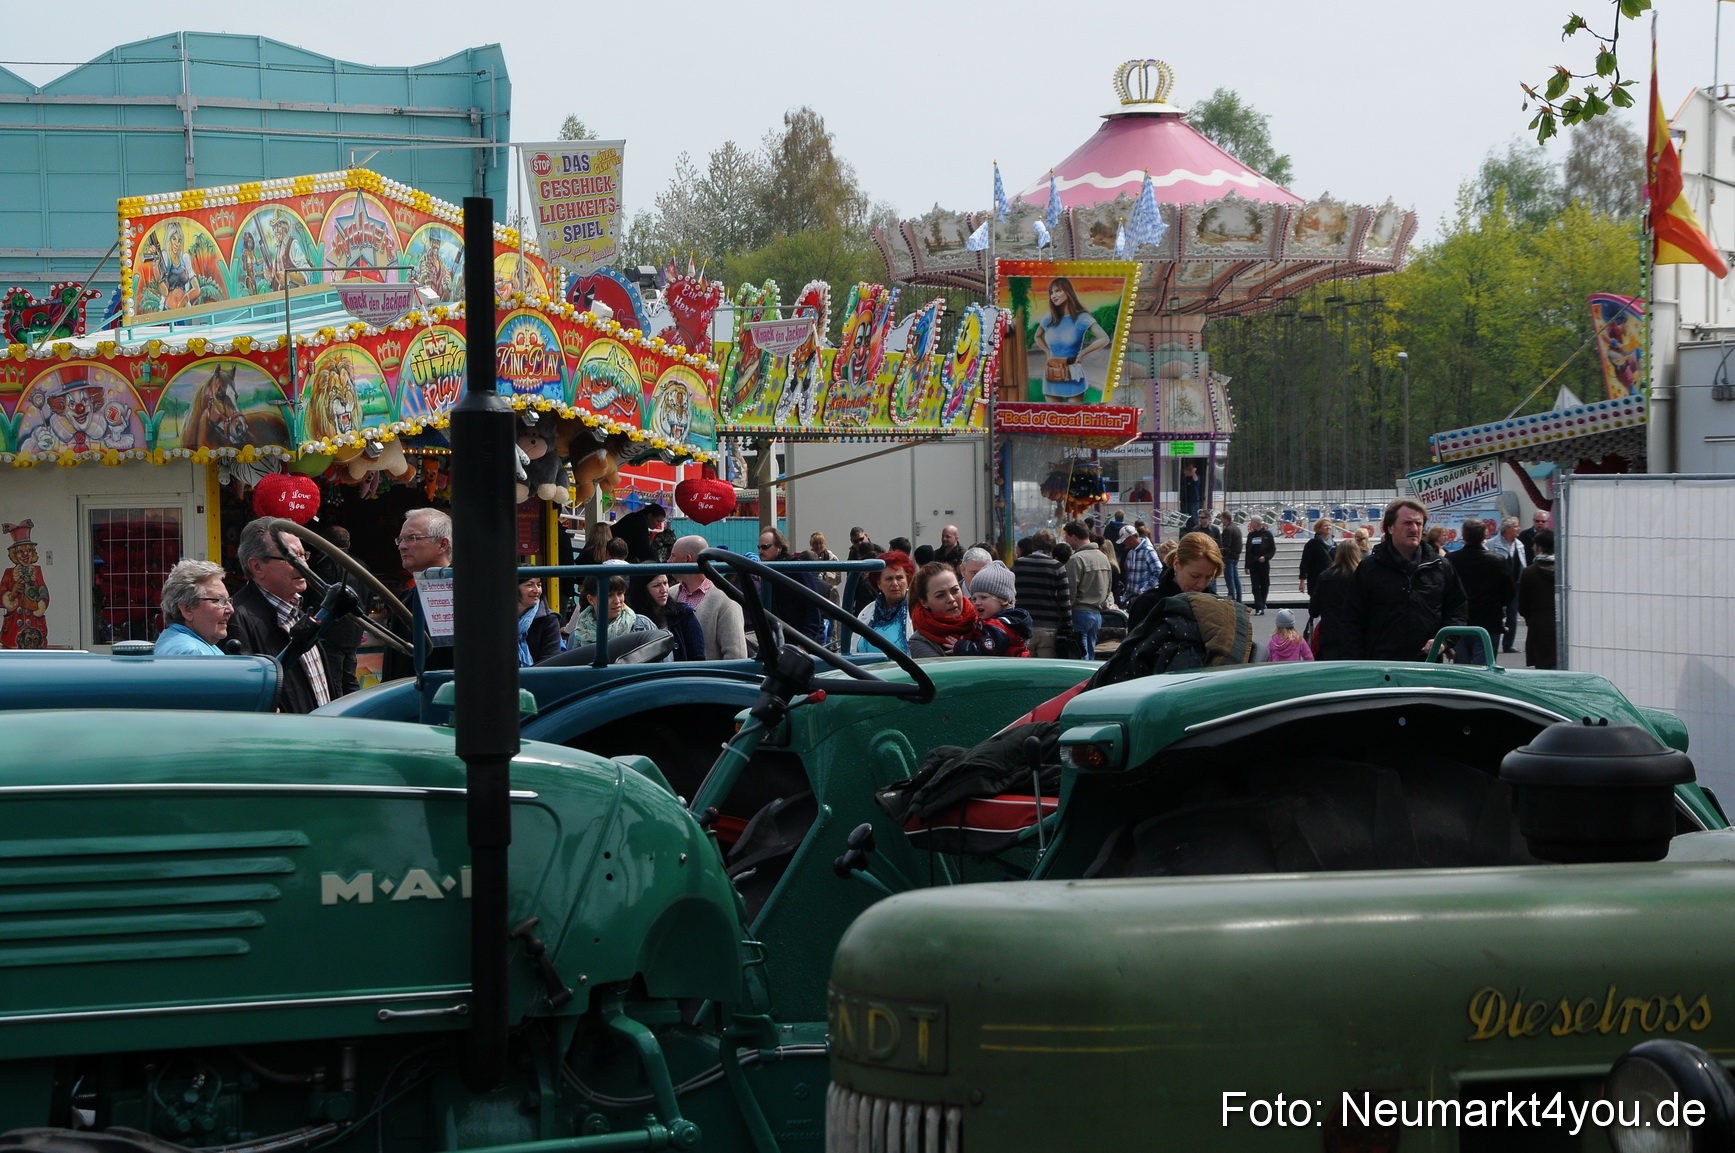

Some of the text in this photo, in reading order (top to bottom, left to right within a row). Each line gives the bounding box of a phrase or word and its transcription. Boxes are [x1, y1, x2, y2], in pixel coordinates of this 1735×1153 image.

[533, 160, 550, 171] STOP
[562, 154, 590, 173] DAS
[540, 175, 616, 199] GESCHICK-
[539, 197, 620, 223] LICHKEITS-
[563, 221, 603, 242] SPIEL
[340, 289, 411, 313] Knack den Jackpot
[410, 349, 466, 386] ULTRA
[496, 345, 561, 377] KING PLAY
[1033, 413, 1045, 425] of
[1047, 413, 1080, 426] Great
[278, 489, 311, 502] I Love
[703, 492, 722, 501] Love
[1421, 472, 1498, 507] FREIE AUSWAHL
[288, 501, 305, 511] You
[698, 501, 714, 510] You
[1465, 985, 1712, 1041] Dieselross
